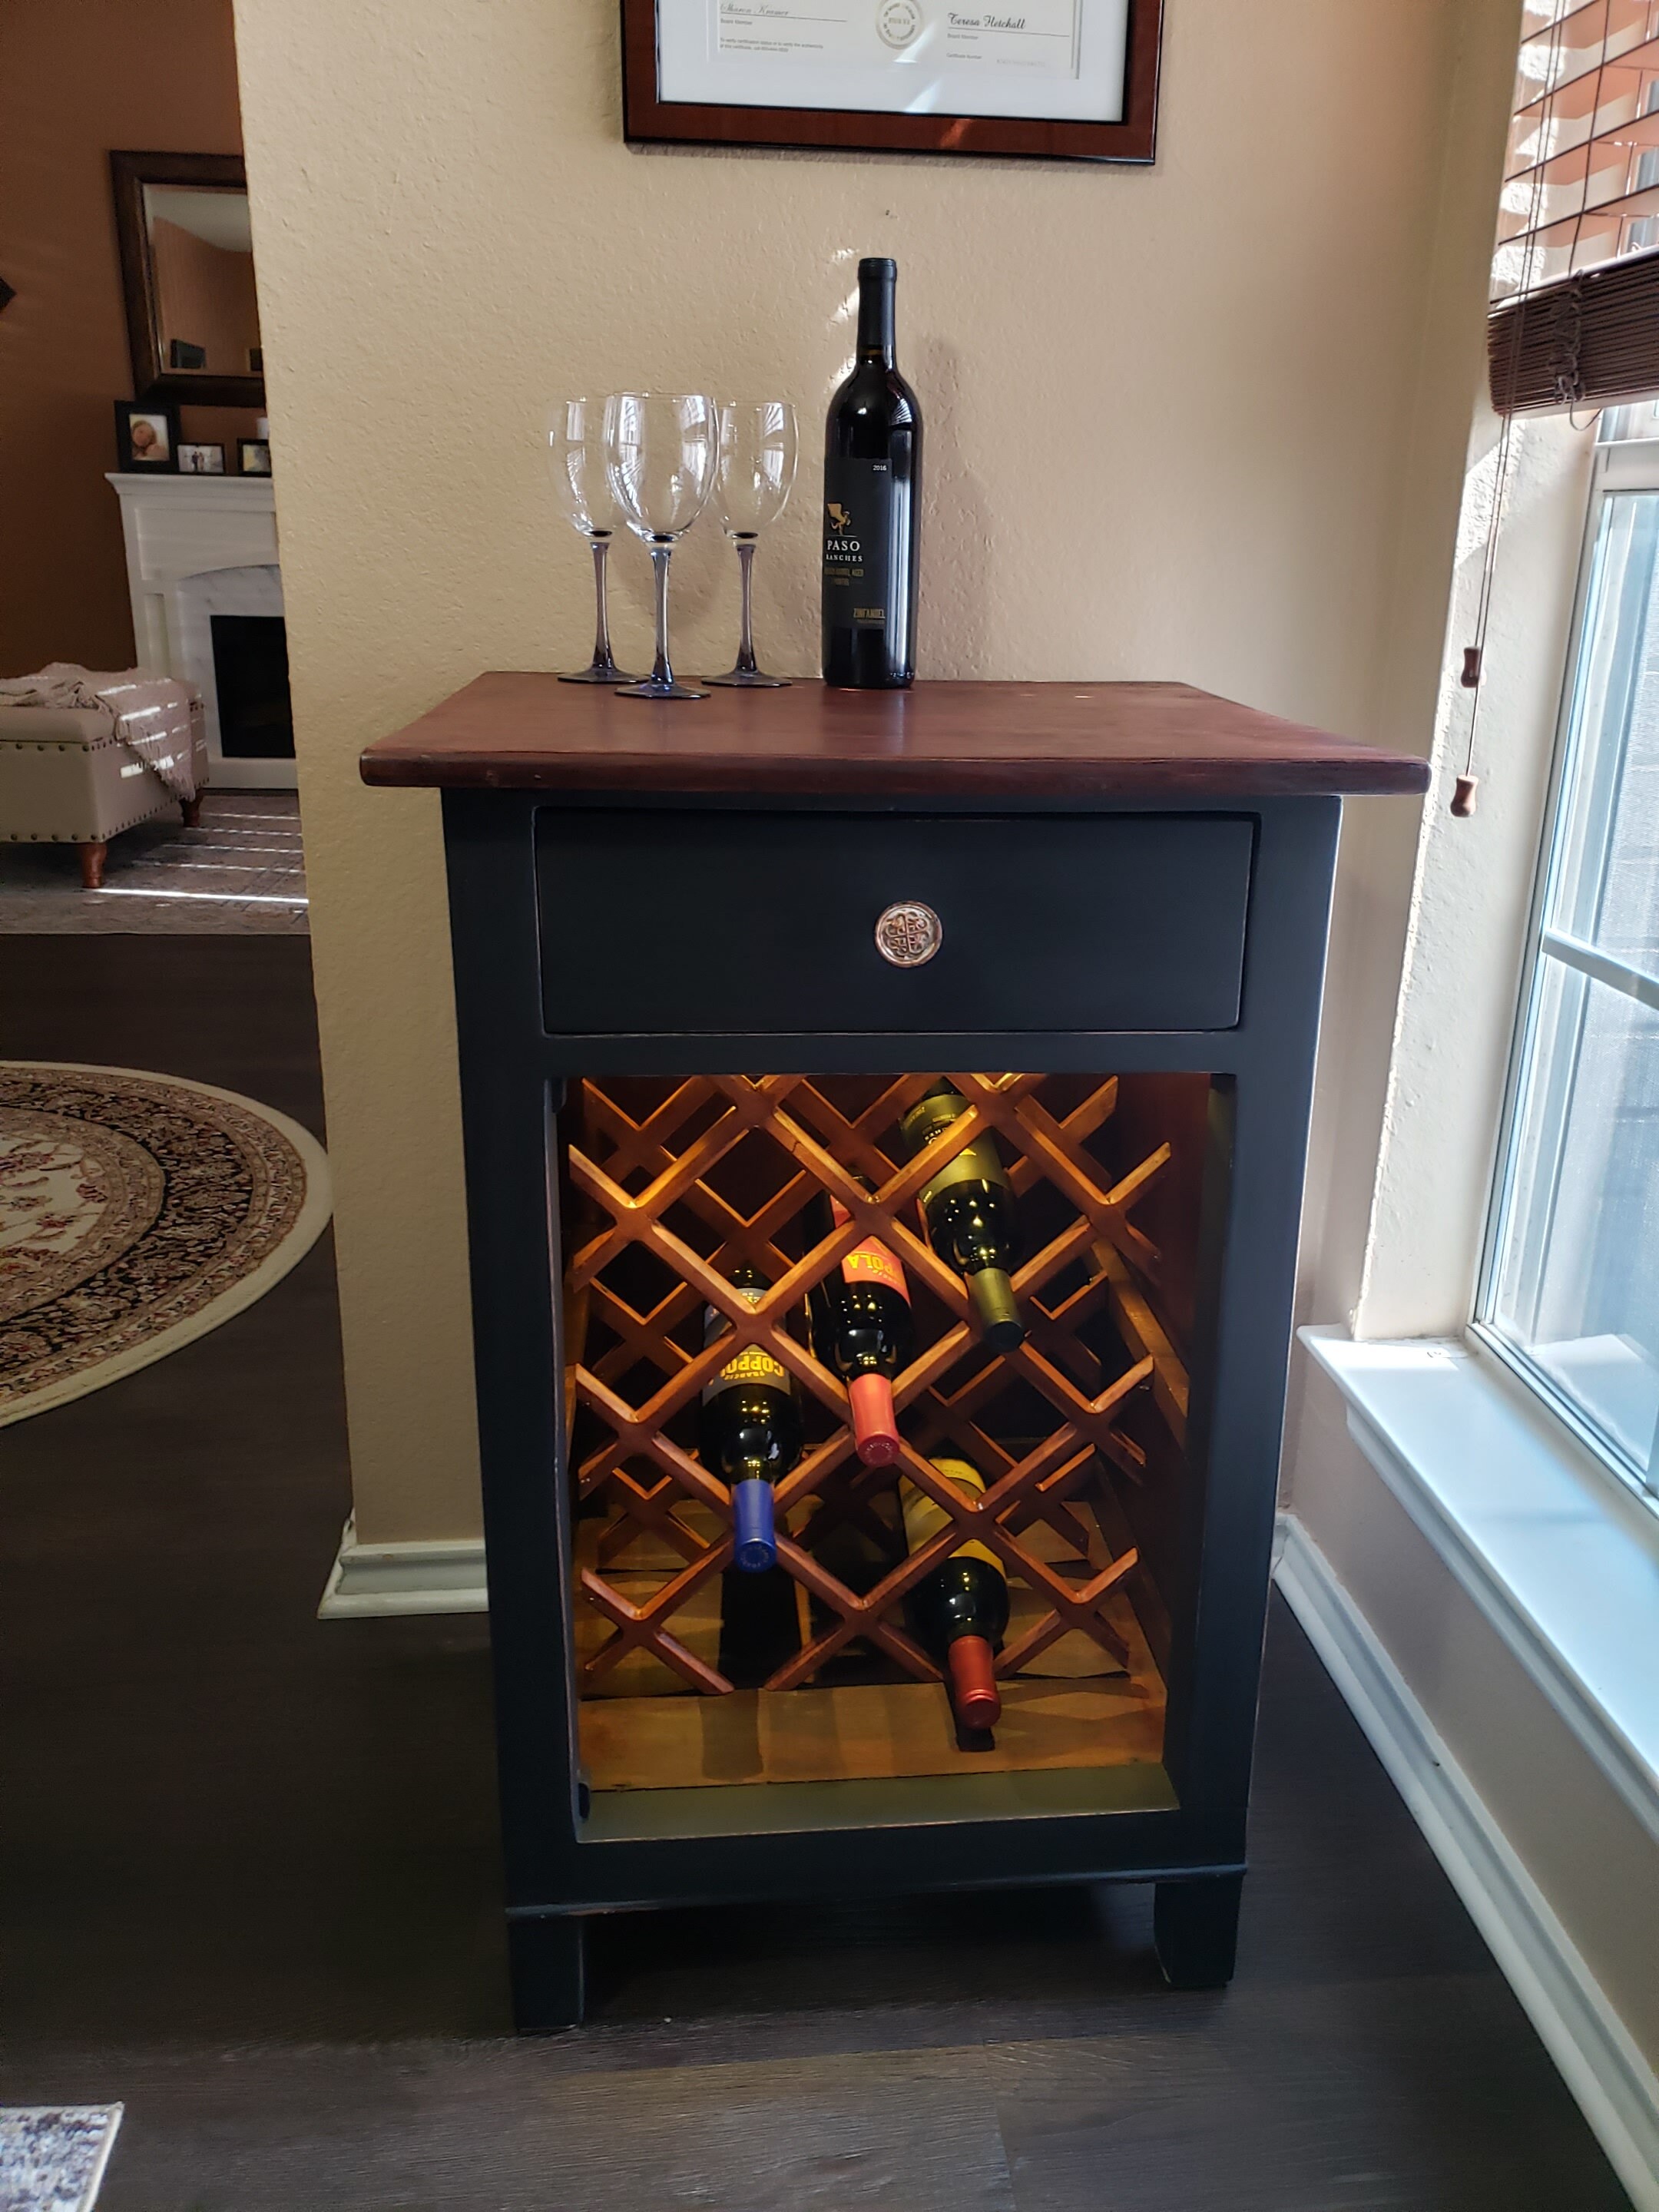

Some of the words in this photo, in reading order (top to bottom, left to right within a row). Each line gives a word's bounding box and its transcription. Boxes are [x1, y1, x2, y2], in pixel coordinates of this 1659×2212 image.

[947, 12, 980, 26] Teresa
[984, 15, 1025, 29] Fletchall
[827, 540, 860, 551] PASO
[846, 1254, 895, 1277] POLA
[719, 1356, 785, 1378] COPPO
